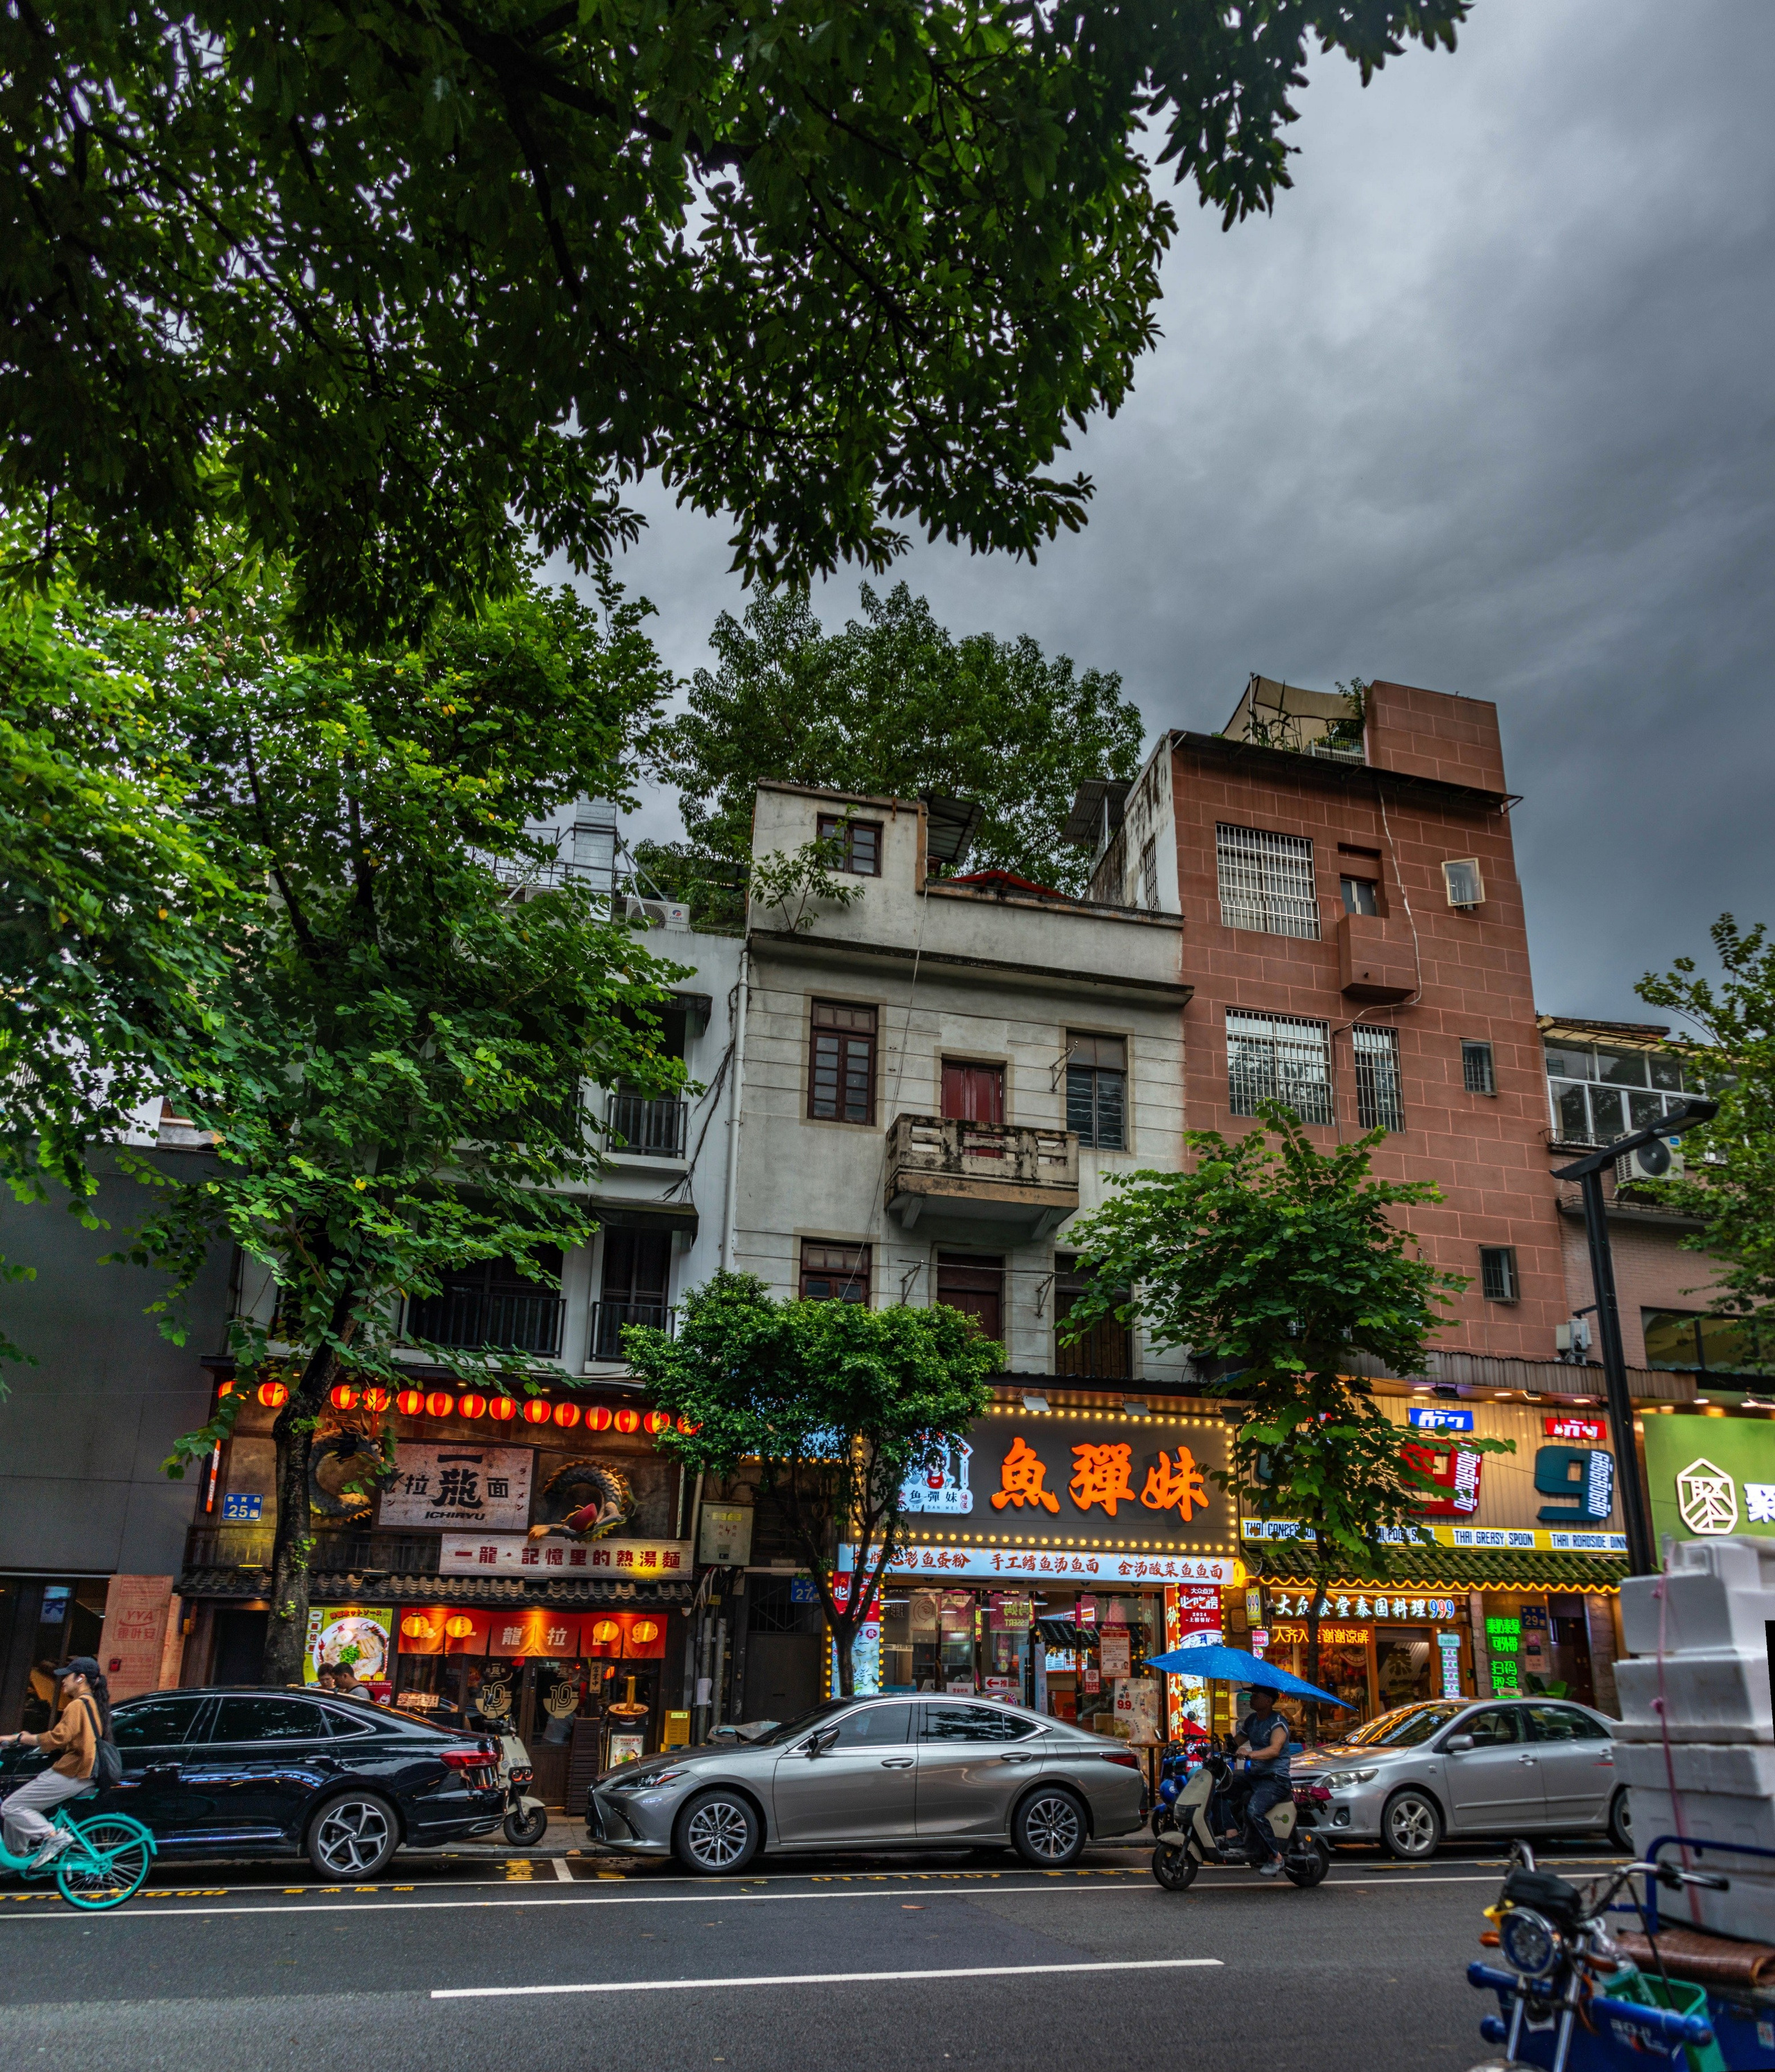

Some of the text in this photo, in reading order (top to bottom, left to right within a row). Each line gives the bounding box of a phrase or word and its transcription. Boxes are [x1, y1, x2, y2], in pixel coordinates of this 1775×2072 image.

[517, 1468, 527, 1511] ラーメン
[227, 1504, 248, 1517] 25
[424, 1511, 485, 1521] ICHIRYU
[1455, 1530, 1534, 1546] THAI GREASY SPOON
[1551, 1534, 1627, 1549] THAI ROADSIDE DINN
[989, 1552, 1100, 1574] 手工鳕鱼汤鱼面
[1118, 1559, 1223, 1581] 金汤酸菜鱼鱼面
[797, 1588, 812, 1601] 27
[1180, 1596, 1218, 1609] 必吃榜
[1247, 1594, 1259, 1613] 999
[1525, 1615, 1539, 1626] 29
[1273, 1628, 1370, 1644] 人齐入谢谢谅解
[1492, 1636, 1518, 1653] 可外带
[1491, 1660, 1518, 1675] 扫码
[1000, 1679, 1008, 1687] 推
[1492, 1676, 1518, 1689] 取号
[1117, 1700, 1132, 1710] 9.9
